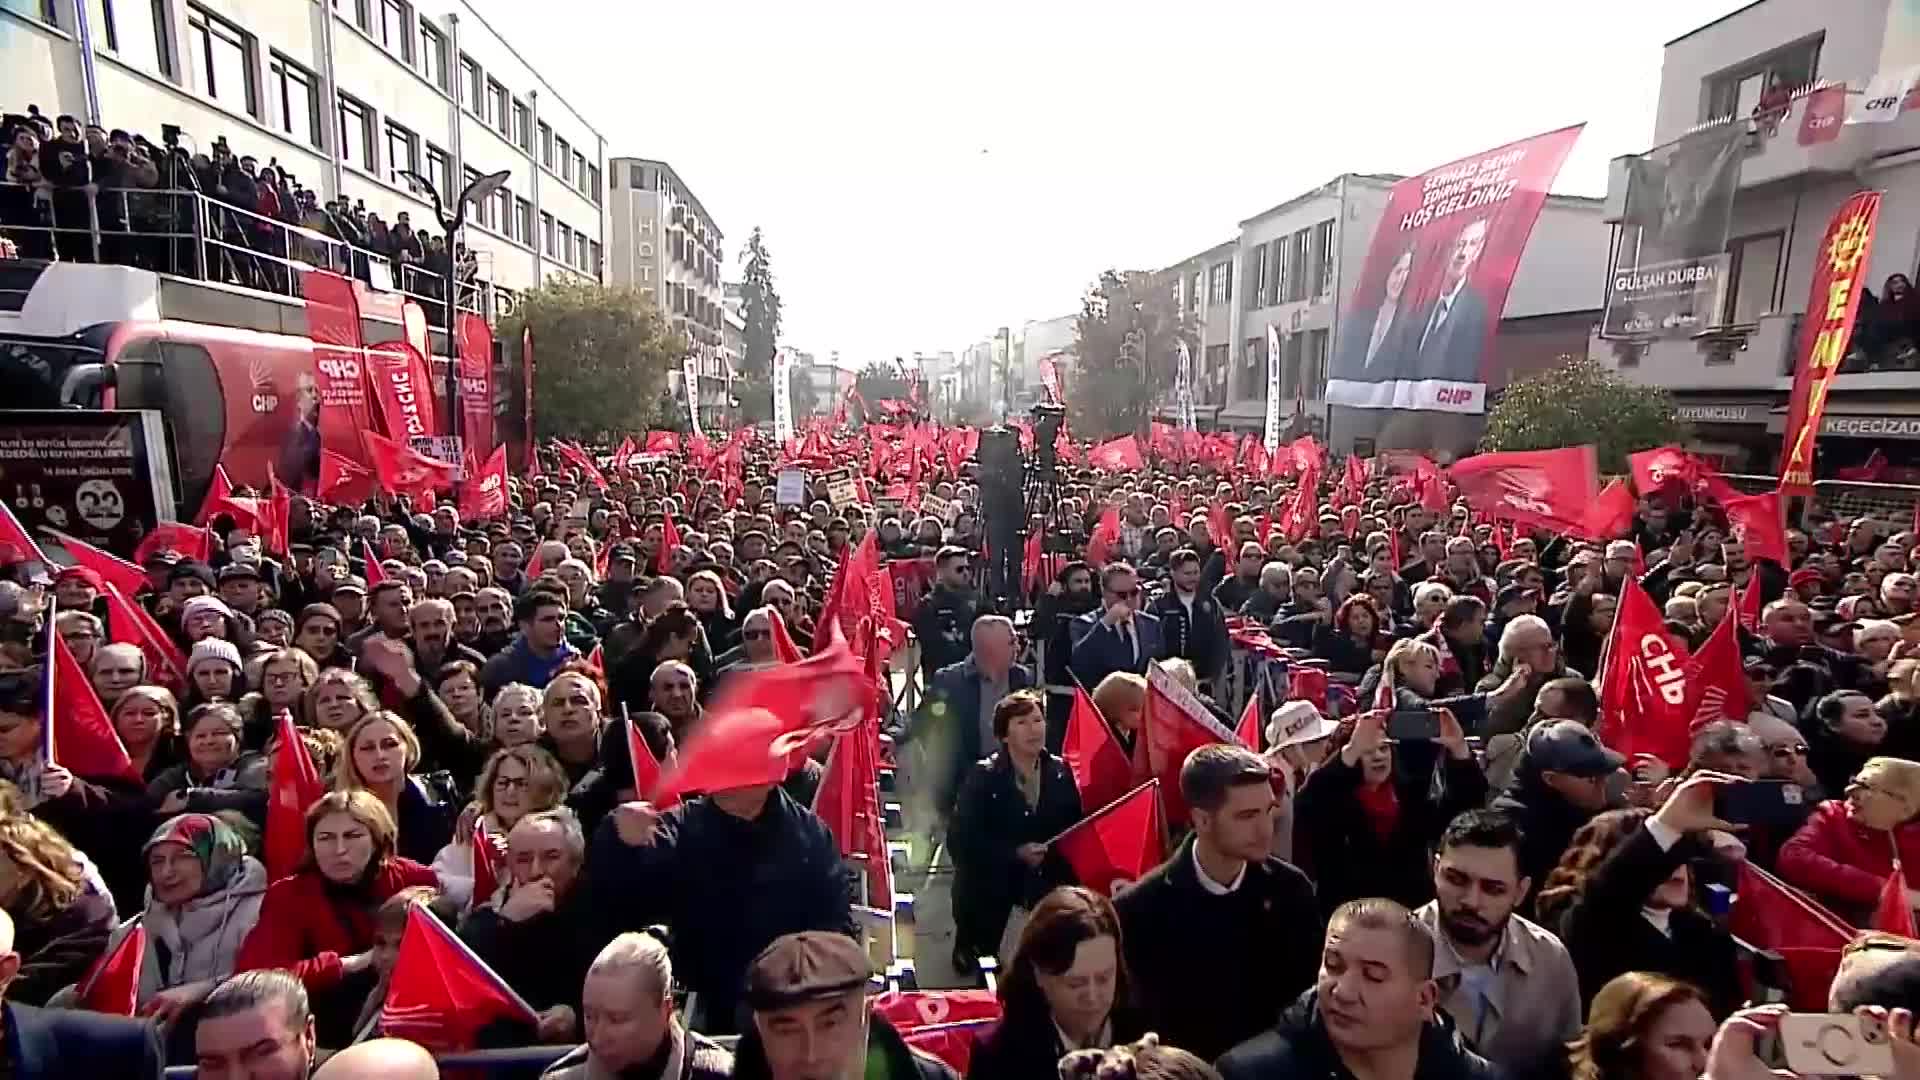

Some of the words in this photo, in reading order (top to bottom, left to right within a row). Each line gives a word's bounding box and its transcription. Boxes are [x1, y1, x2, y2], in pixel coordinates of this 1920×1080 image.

[1865, 97, 1898, 110] CHP
[1808, 116, 1835, 129] CHP
[1400, 203, 1435, 232] HOŞ
[638, 218, 655, 293] HOT
[252, 395, 279, 412] CHP
[1437, 388, 1473, 405] CHP
[1678, 407, 1748, 420] UYUMCUSU
